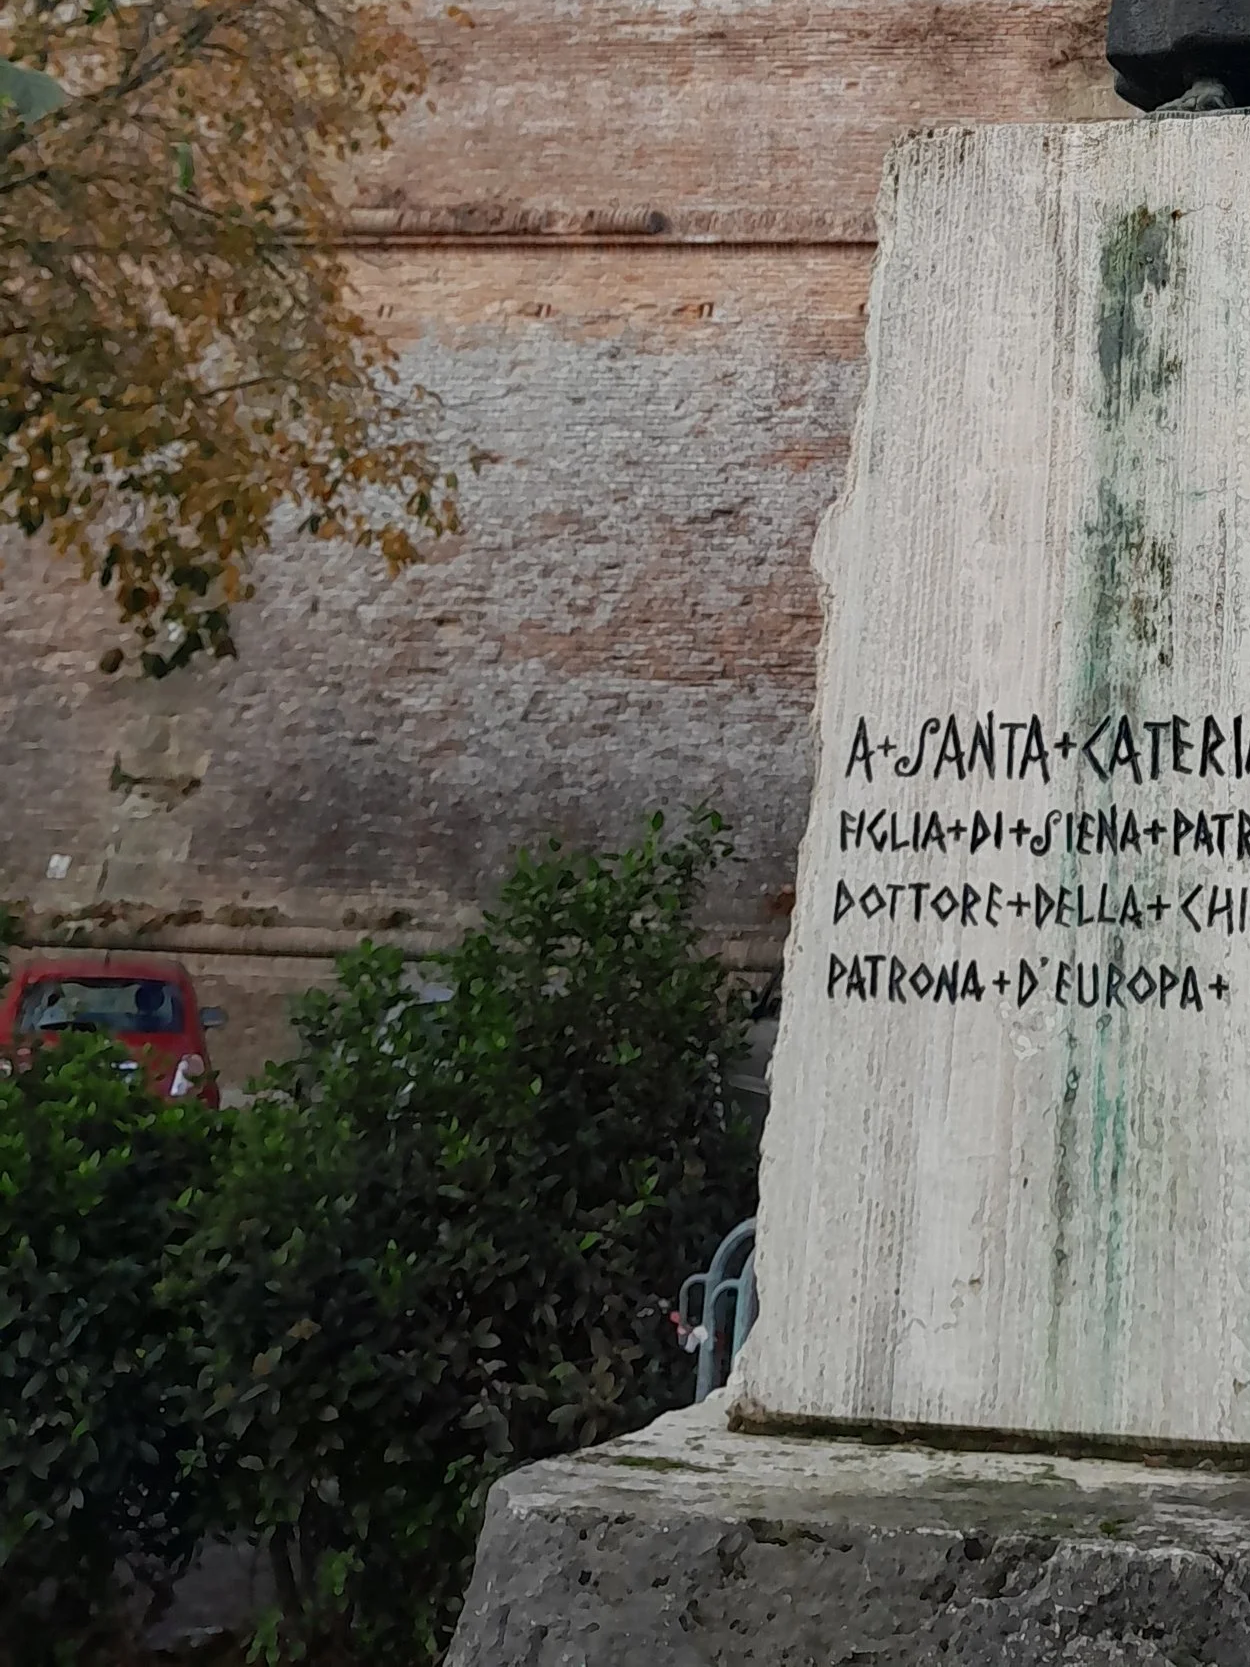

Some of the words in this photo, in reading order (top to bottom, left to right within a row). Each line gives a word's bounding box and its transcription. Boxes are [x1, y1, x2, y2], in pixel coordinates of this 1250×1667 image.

[895, 710, 1050, 784] SANTA
[840, 809, 947, 853] FIGLIA
[1030, 803, 1141, 856] SIENA
[833, 879, 1003, 927] DOTTORE
[1035, 883, 1142, 929] DELLA
[828, 953, 985, 1005] PATRONA
[1017, 956, 1203, 1012] D'EUROPA
